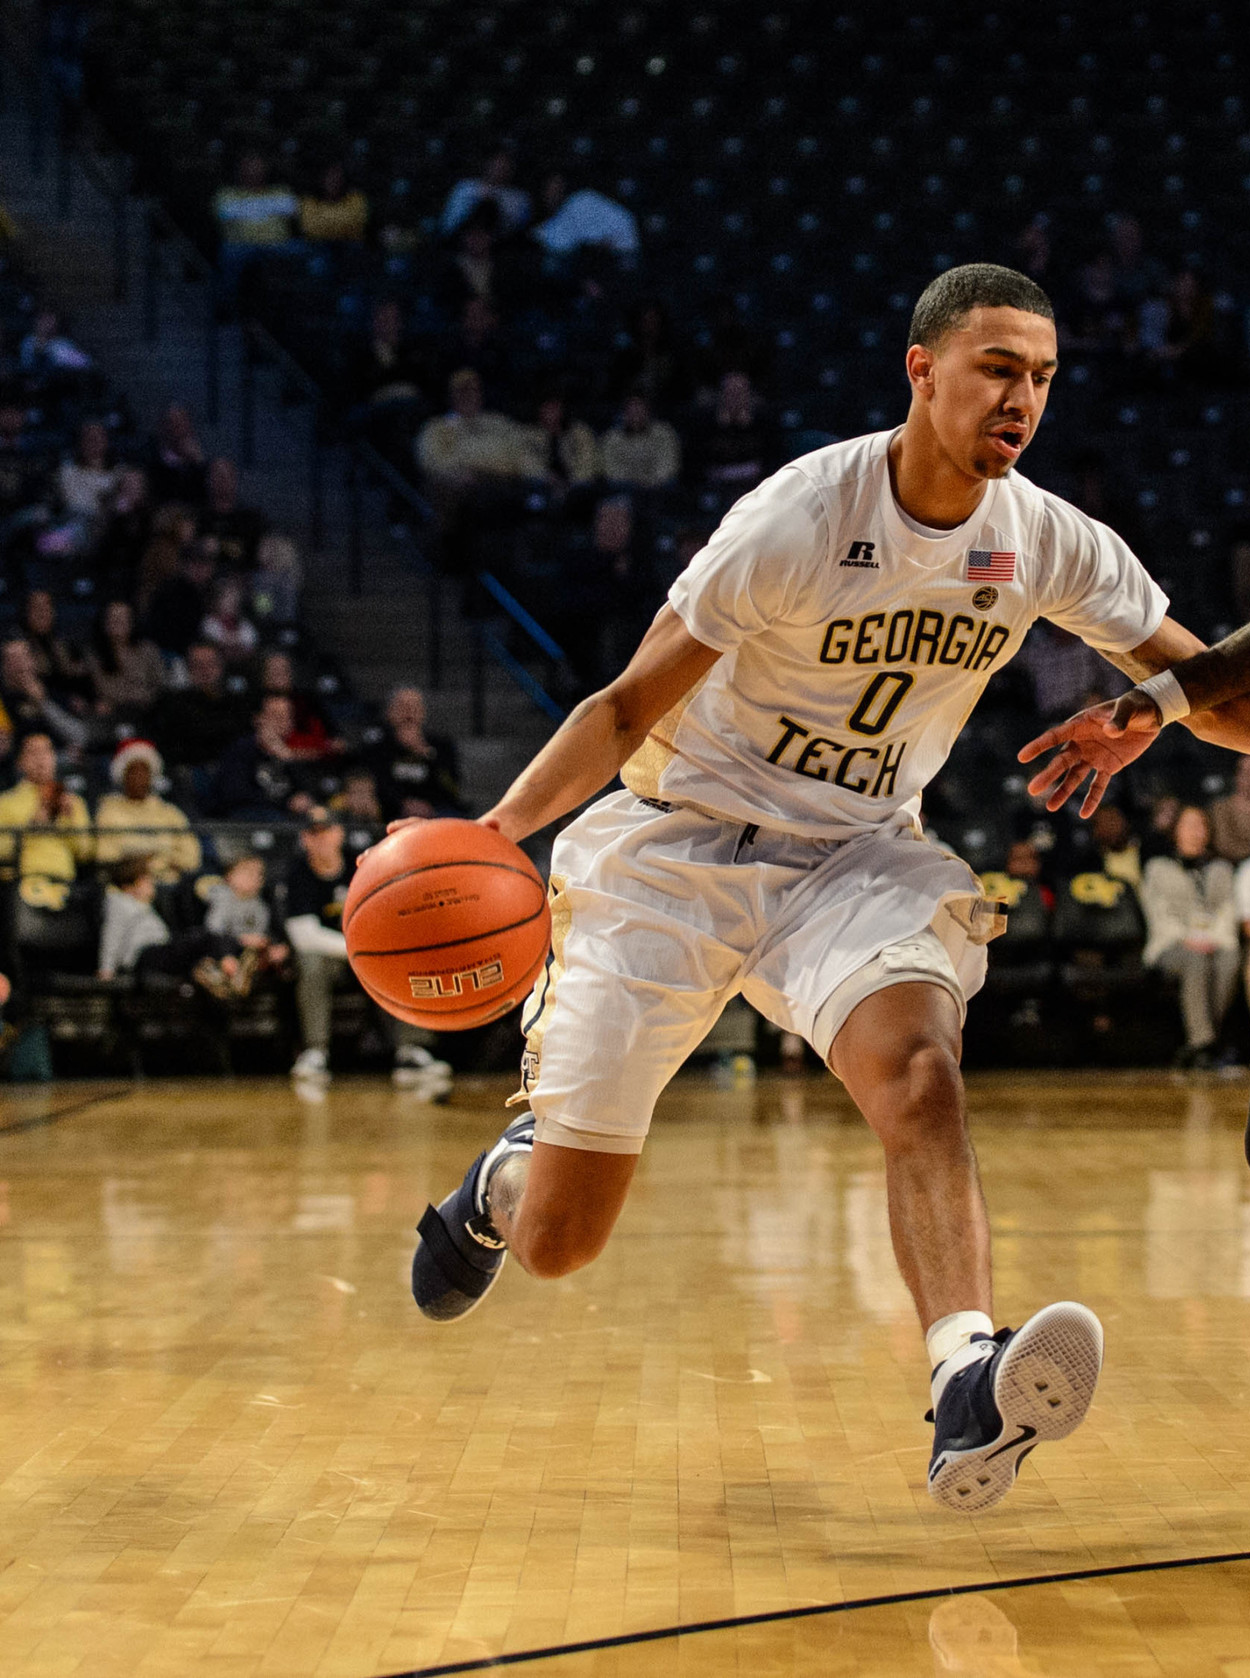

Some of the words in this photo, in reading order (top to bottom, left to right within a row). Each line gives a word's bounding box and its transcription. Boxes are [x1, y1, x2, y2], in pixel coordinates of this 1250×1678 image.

[839, 560, 880, 568] RUSSELL
[819, 608, 1010, 671] GEORGIA
[846, 670, 917, 738] 0
[765, 713, 908, 798] TECH
[408, 959, 504, 998] ELITE
